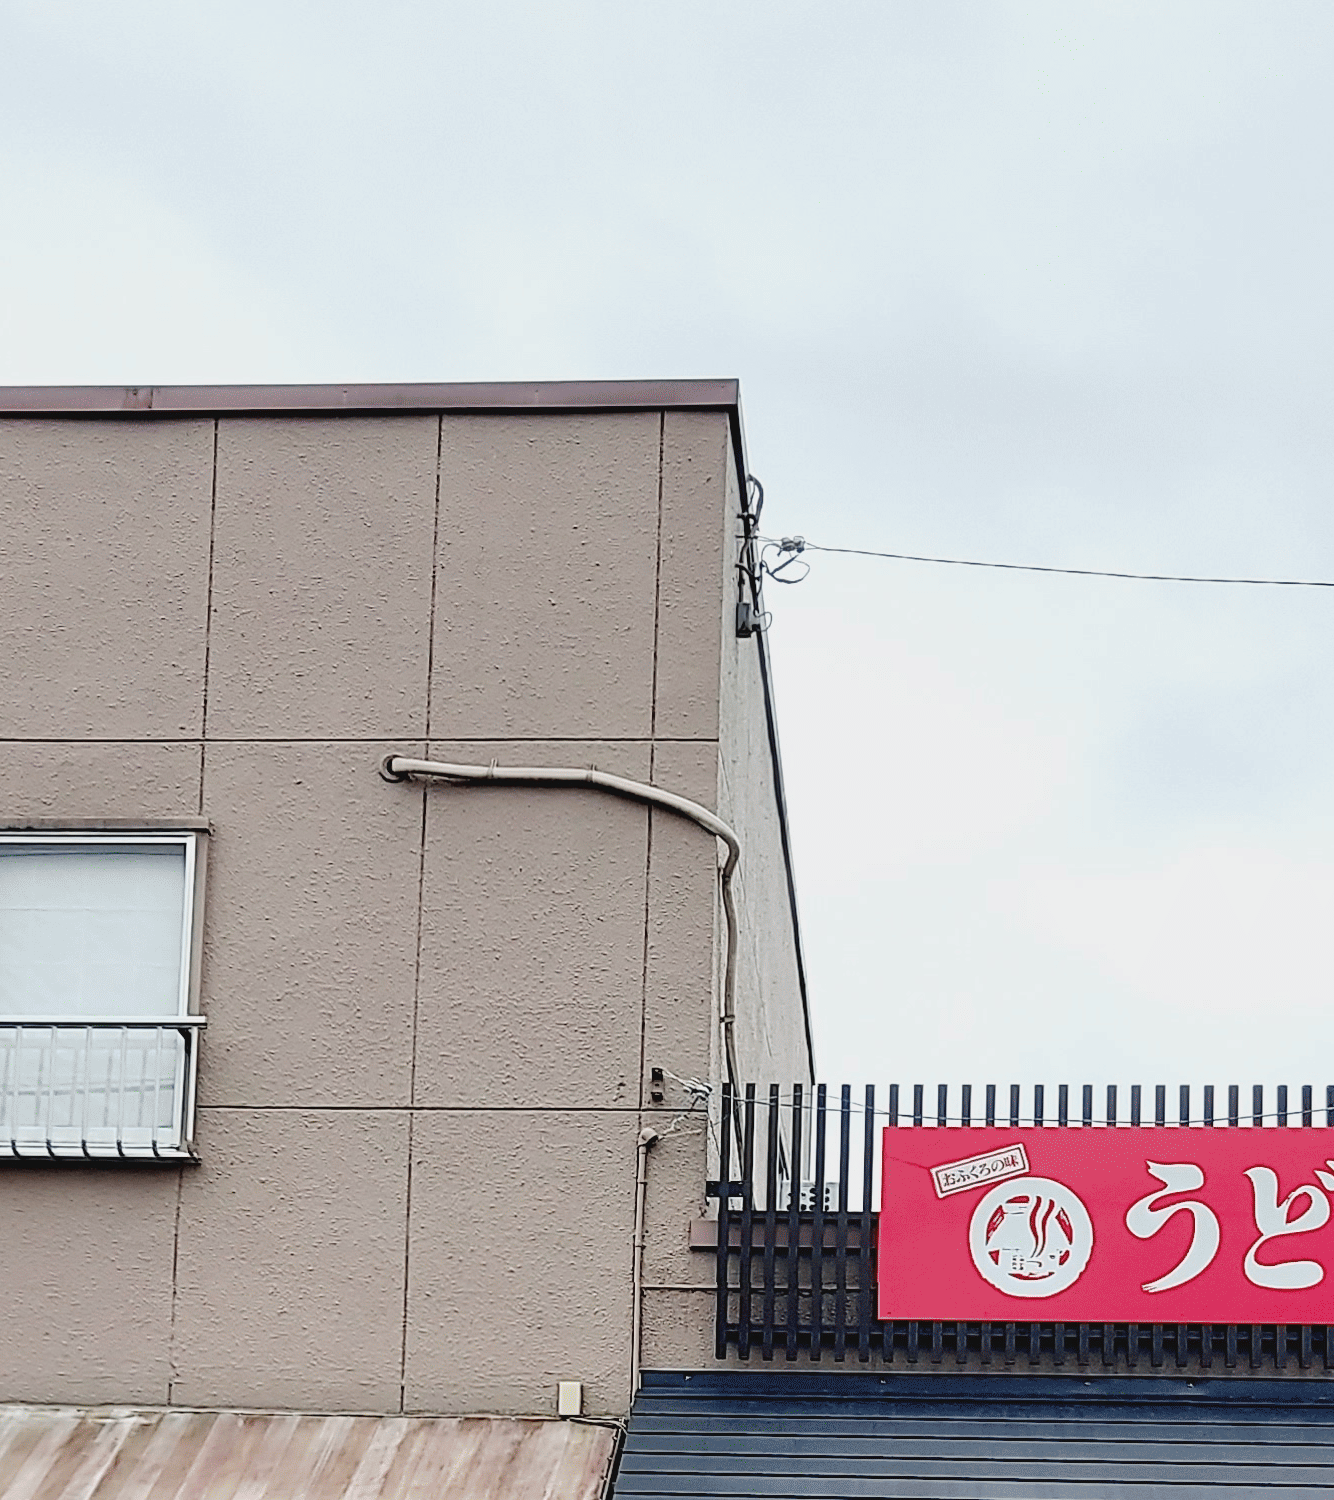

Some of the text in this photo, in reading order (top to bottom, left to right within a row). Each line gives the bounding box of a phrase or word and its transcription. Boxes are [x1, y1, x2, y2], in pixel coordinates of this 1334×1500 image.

[942, 1154, 1020, 1188] おふくろの味
